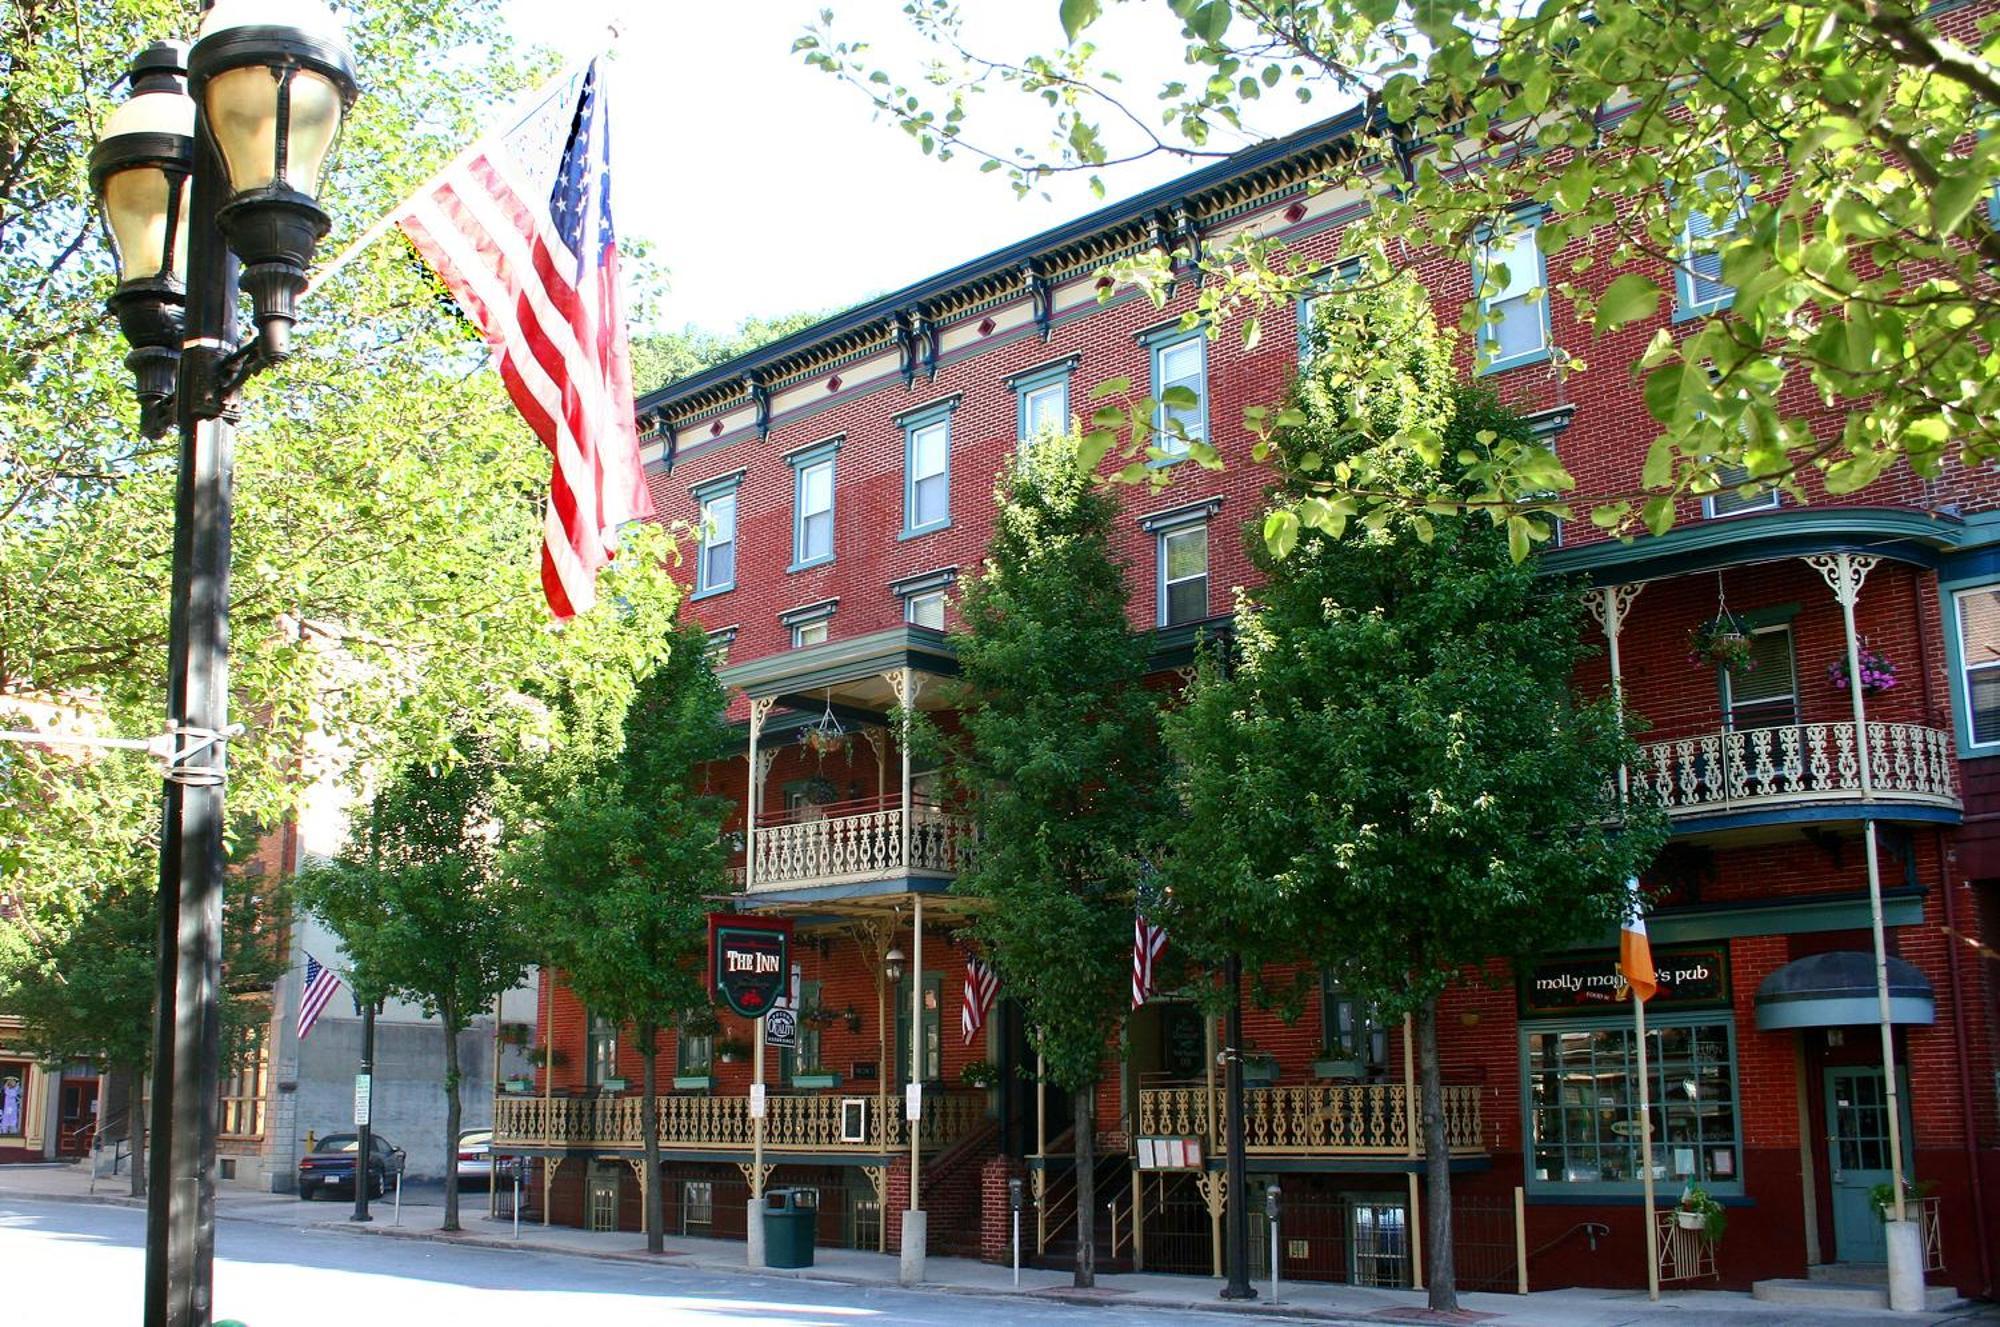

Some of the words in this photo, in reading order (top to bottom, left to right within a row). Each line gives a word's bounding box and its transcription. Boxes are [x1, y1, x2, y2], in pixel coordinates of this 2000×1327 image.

[727, 950, 754, 972] THE
[755, 951, 780, 973] INN
[1536, 974, 1583, 992] molly
[1587, 968, 1671, 989] mage's
[1675, 965, 1709, 985] pub
